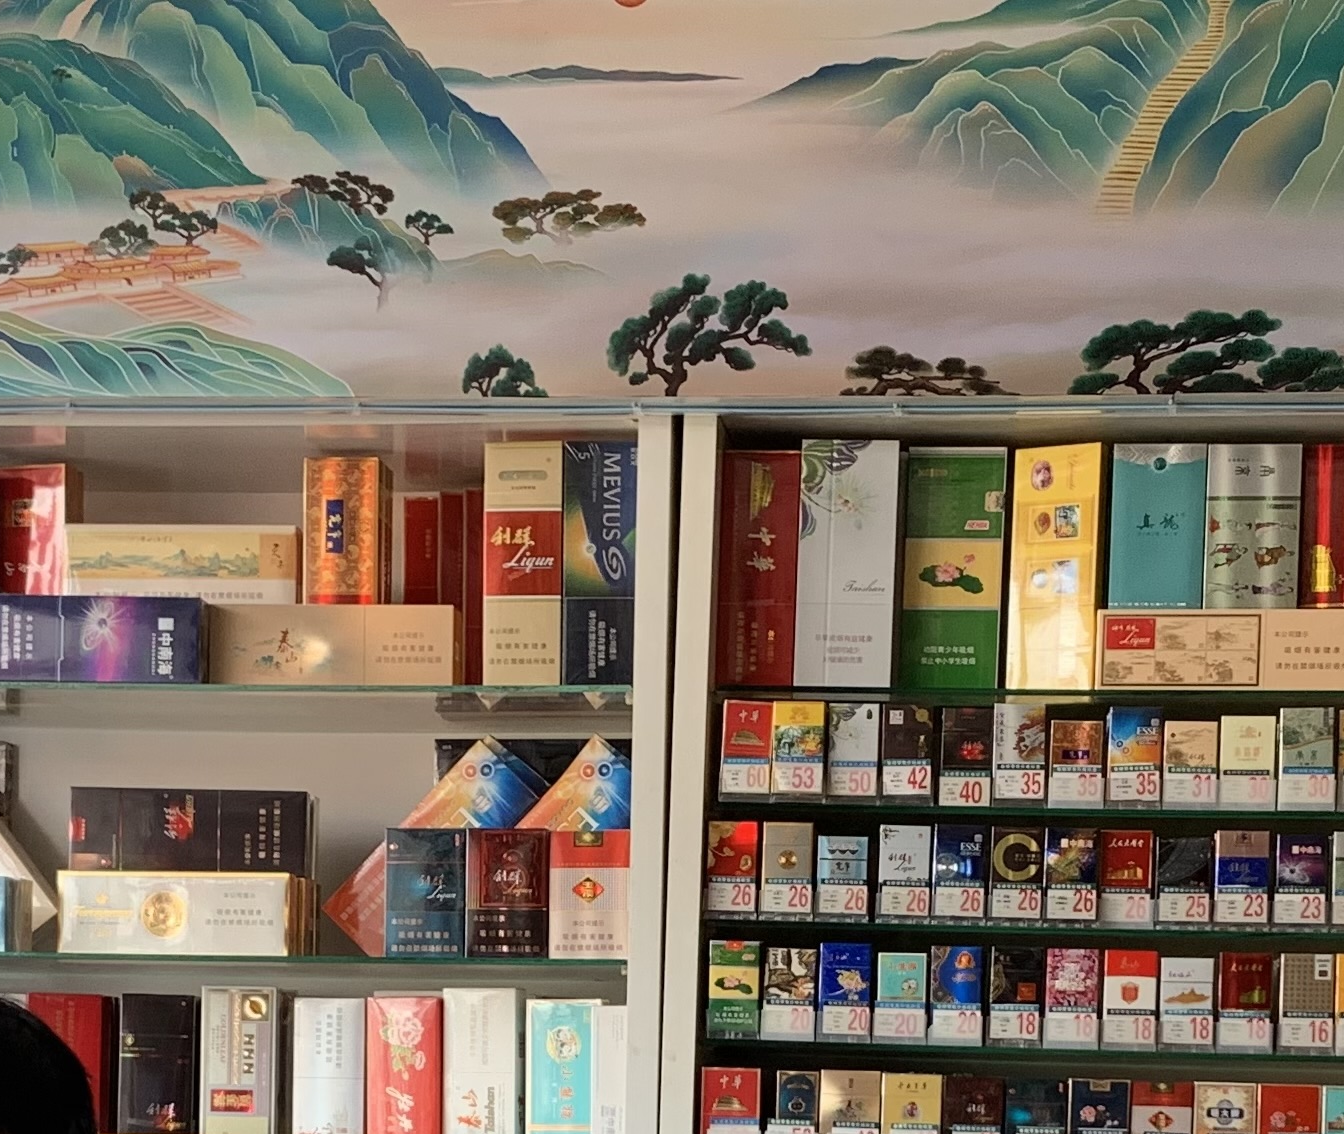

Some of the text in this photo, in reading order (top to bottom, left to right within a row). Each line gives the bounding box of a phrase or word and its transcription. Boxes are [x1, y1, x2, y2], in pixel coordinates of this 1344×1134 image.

[601, 452, 622, 541] MEVIUS
[503, 548, 555, 573] Liqun
[157, 632, 174, 676] 中南海
[274, 628, 301, 670] 泰山
[792, 767, 815, 789] 53
[908, 768, 928, 789] 42
[1023, 773, 1041, 794] 35
[1137, 773, 1157, 795] 35
[960, 781, 981, 803] 40
[960, 842, 982, 851] ESSE
[732, 885, 752, 906] 26
[789, 886, 809, 907] 26
[907, 890, 930, 912] 26
[960, 889, 981, 911] 26
[1019, 889, 1040, 910] 26
[1073, 889, 1097, 912] 26
[1018, 1013, 1038, 1034] 18
[1190, 1017, 1211, 1040] 18
[1311, 1021, 1328, 1041] 16
